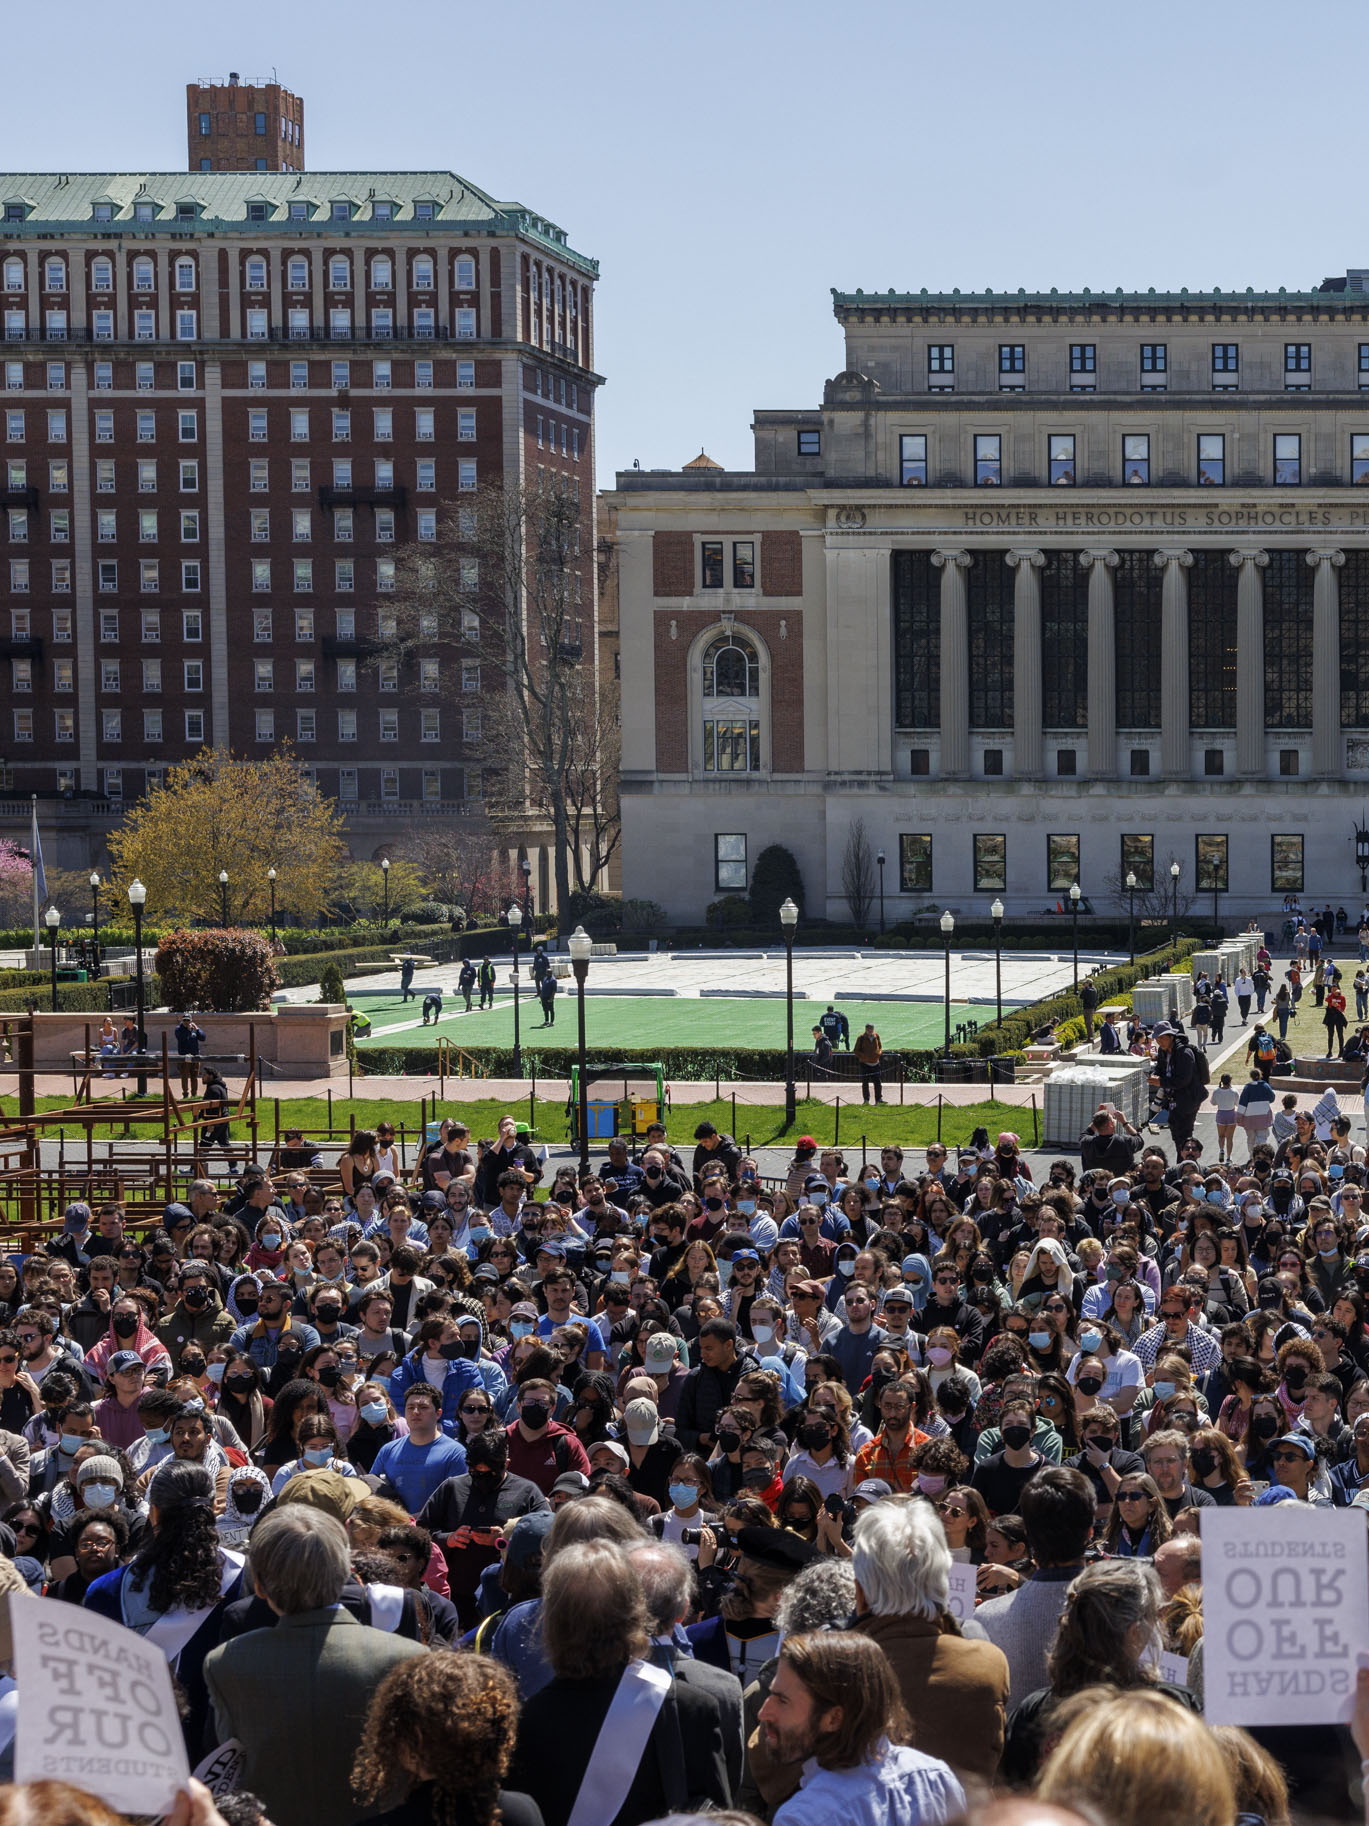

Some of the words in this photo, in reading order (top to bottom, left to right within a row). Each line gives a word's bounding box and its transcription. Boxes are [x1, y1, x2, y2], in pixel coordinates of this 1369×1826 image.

[964, 511, 1040, 526] HOMER
[1055, 511, 1187, 526] HERODOTUS
[1205, 511, 1331, 526] SOPHOCLES
[203, 1748, 237, 1788] ND
